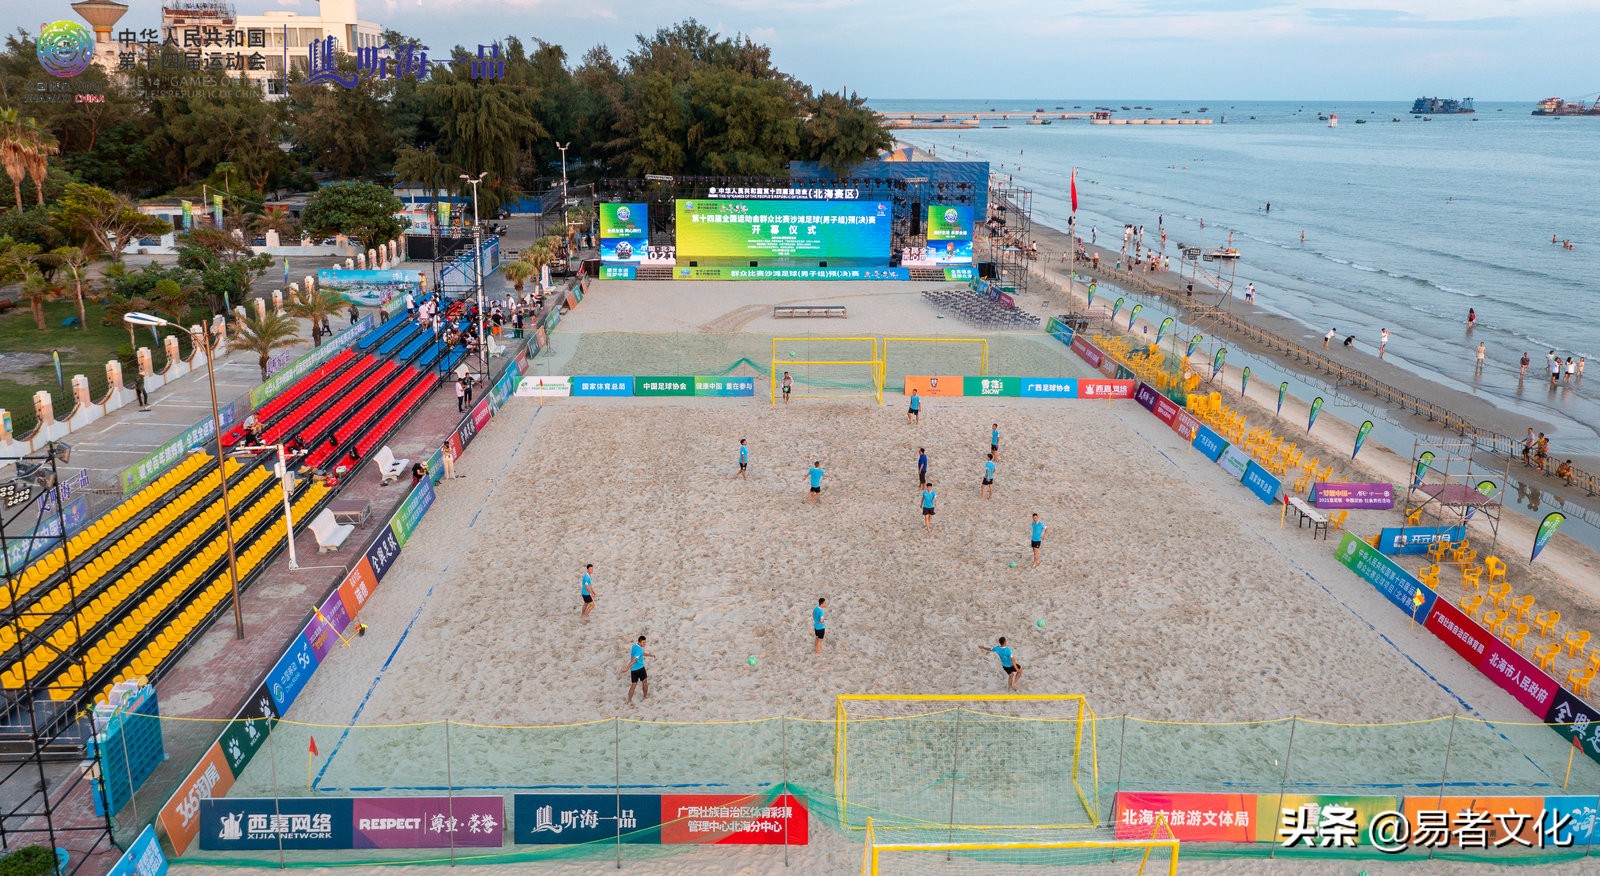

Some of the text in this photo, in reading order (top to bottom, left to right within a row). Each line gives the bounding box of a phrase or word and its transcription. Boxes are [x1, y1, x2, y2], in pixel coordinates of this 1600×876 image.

[581, 382, 626, 391] 国家体育总局
[643, 382, 687, 391] 中国足球协会
[1027, 383, 1071, 392] 广西足球协会
[1488, 652, 1549, 705] 北海市人民政府
[560, 808, 637, 829] 听海一品
[677, 805, 793, 819] 广西壮族自治区体育彩票
[1122, 808, 1250, 828] 北海市旅游文体局
[247, 813, 332, 833] 西嘉网络
[359, 817, 421, 831] RESPECT
[687, 819, 783, 833] 管理中心北海分中心
[247, 832, 333, 840] XIJIA NETWORK
